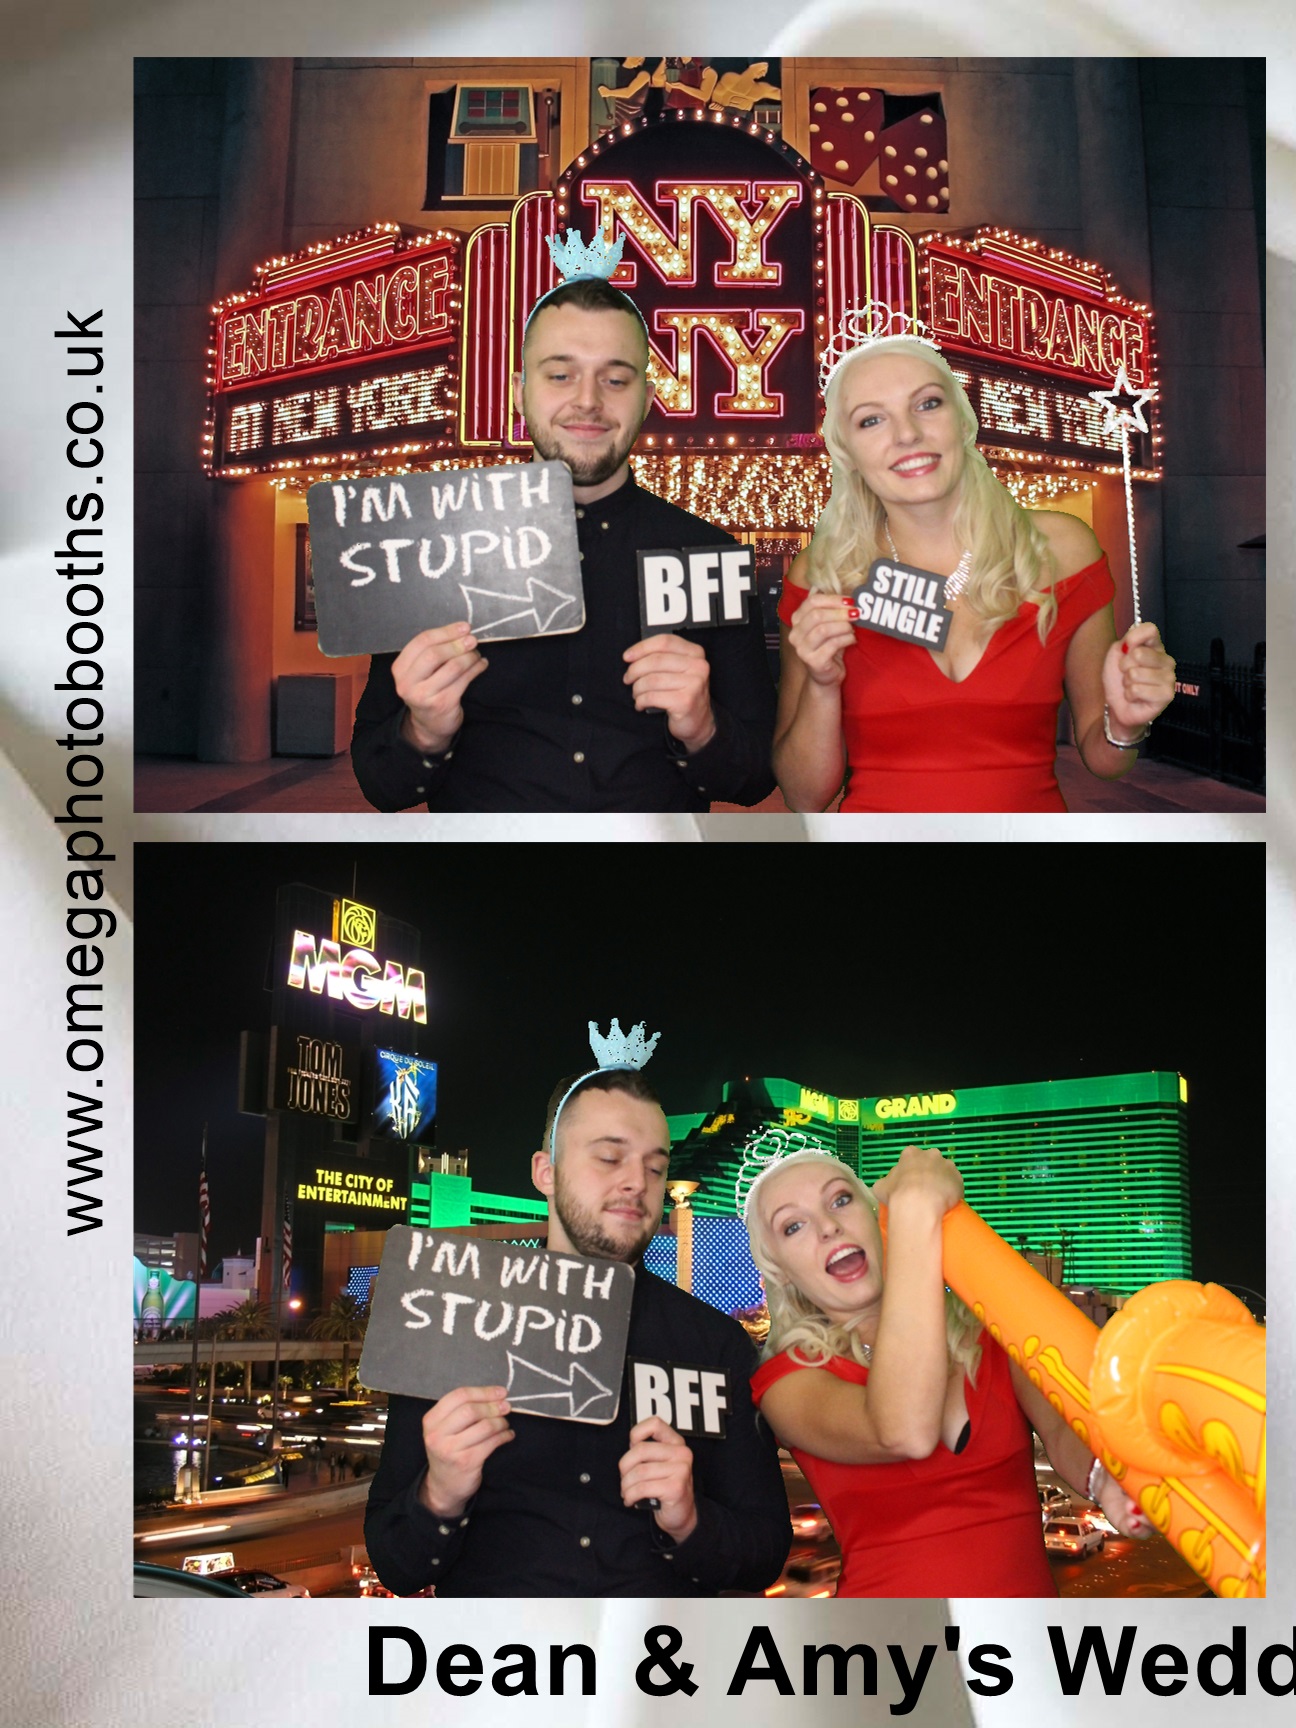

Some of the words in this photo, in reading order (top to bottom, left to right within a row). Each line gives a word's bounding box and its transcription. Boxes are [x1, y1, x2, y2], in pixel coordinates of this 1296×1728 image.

[581, 180, 802, 286] NY
[222, 256, 449, 380] ENTRANCE
[929, 257, 1145, 383] ENTRANCE
[333, 482, 412, 527] I'M
[644, 551, 751, 626] BFF
[873, 565, 938, 610] STILL
[858, 592, 944, 643] SINGLE
[287, 930, 427, 1025] MGM
[297, 1035, 343, 1078] TOM
[379, 1050, 403, 1063] CIRQUE
[414, 1059, 435, 1071] SOLEIL
[287, 1074, 350, 1120] JONES
[875, 1094, 957, 1119] GRAND
[298, 1184, 408, 1211] ENTERTAINMENT
[316, 1169, 342, 1186] THE
[345, 1173, 374, 1190] CITY
[376, 1178, 394, 1192] OF
[409, 1232, 480, 1279] I'M
[634, 1363, 726, 1433] BFF
